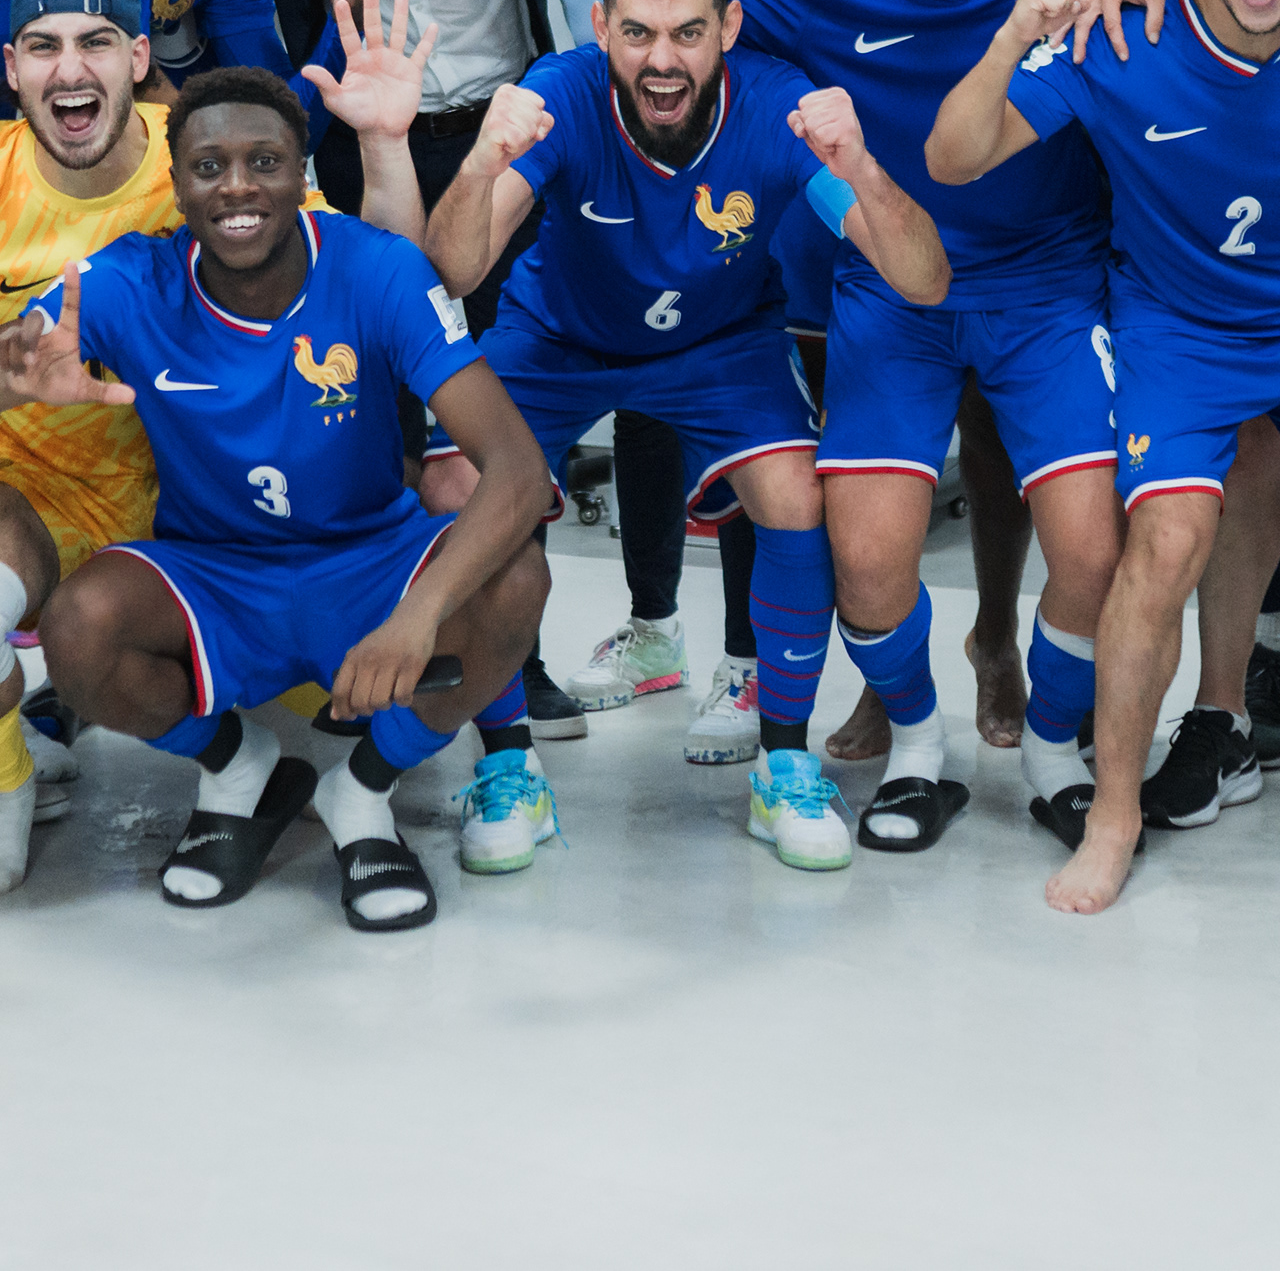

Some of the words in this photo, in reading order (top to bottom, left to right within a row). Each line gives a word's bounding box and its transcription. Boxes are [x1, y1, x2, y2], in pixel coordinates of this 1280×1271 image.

[1219, 196, 1263, 255] 2
[645, 290, 681, 330] 6
[248, 466, 291, 518] 3
